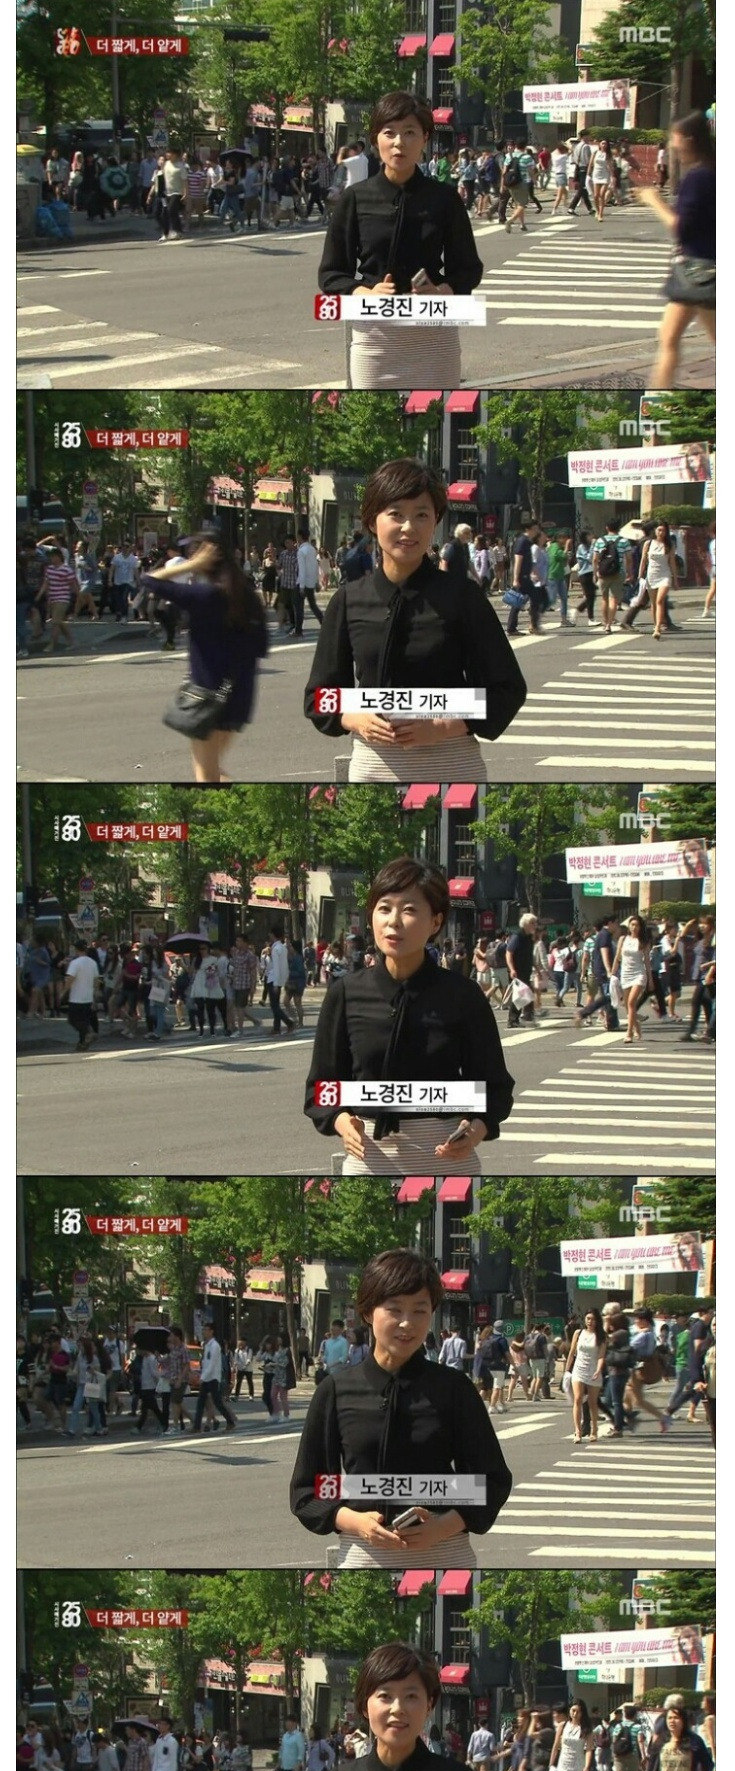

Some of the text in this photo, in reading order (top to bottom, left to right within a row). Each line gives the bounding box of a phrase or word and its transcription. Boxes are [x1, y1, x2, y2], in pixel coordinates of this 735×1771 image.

[571, 460, 619, 473] 박정현 콘서트
[568, 855, 616, 869] 박정현 콘서트
[563, 1248, 612, 1262] 박정현 콘서트
[564, 1642, 612, 1656] 박정현 콘서트
